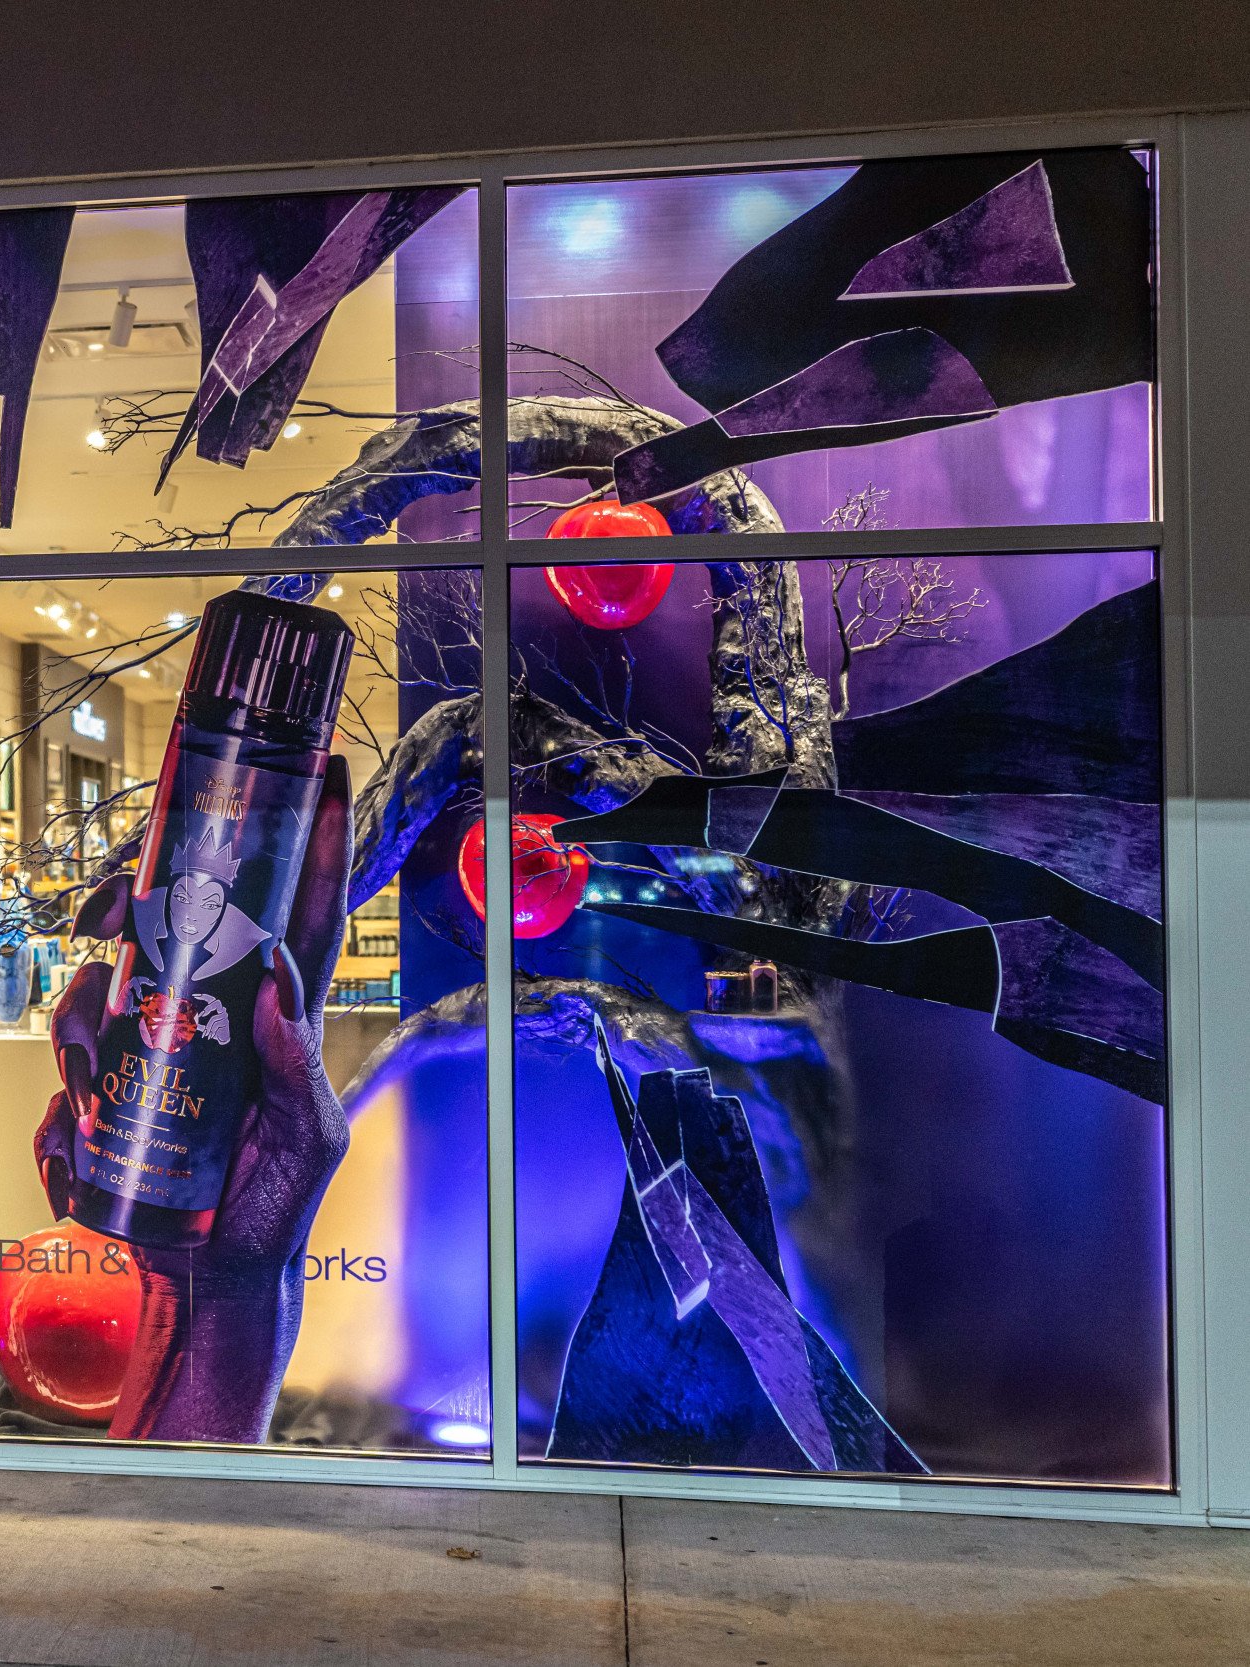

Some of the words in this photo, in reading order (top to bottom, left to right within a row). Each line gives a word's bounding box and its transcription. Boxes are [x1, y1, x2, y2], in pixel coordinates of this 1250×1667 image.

[194, 791, 246, 821] VILLAINS
[118, 1051, 190, 1093] EVIL
[102, 1071, 205, 1120] QUEEN
[95, 1118, 115, 1135] Bath
[116, 1128, 123, 1139] &
[84, 1141, 101, 1156] FINE
[102, 1149, 164, 1176] FRAGRANCE
[110, 1173, 125, 1186] OZ
[133, 1181, 152, 1193] 236
[99, 1242, 129, 1275] &
[304, 1247, 387, 1283] orks
